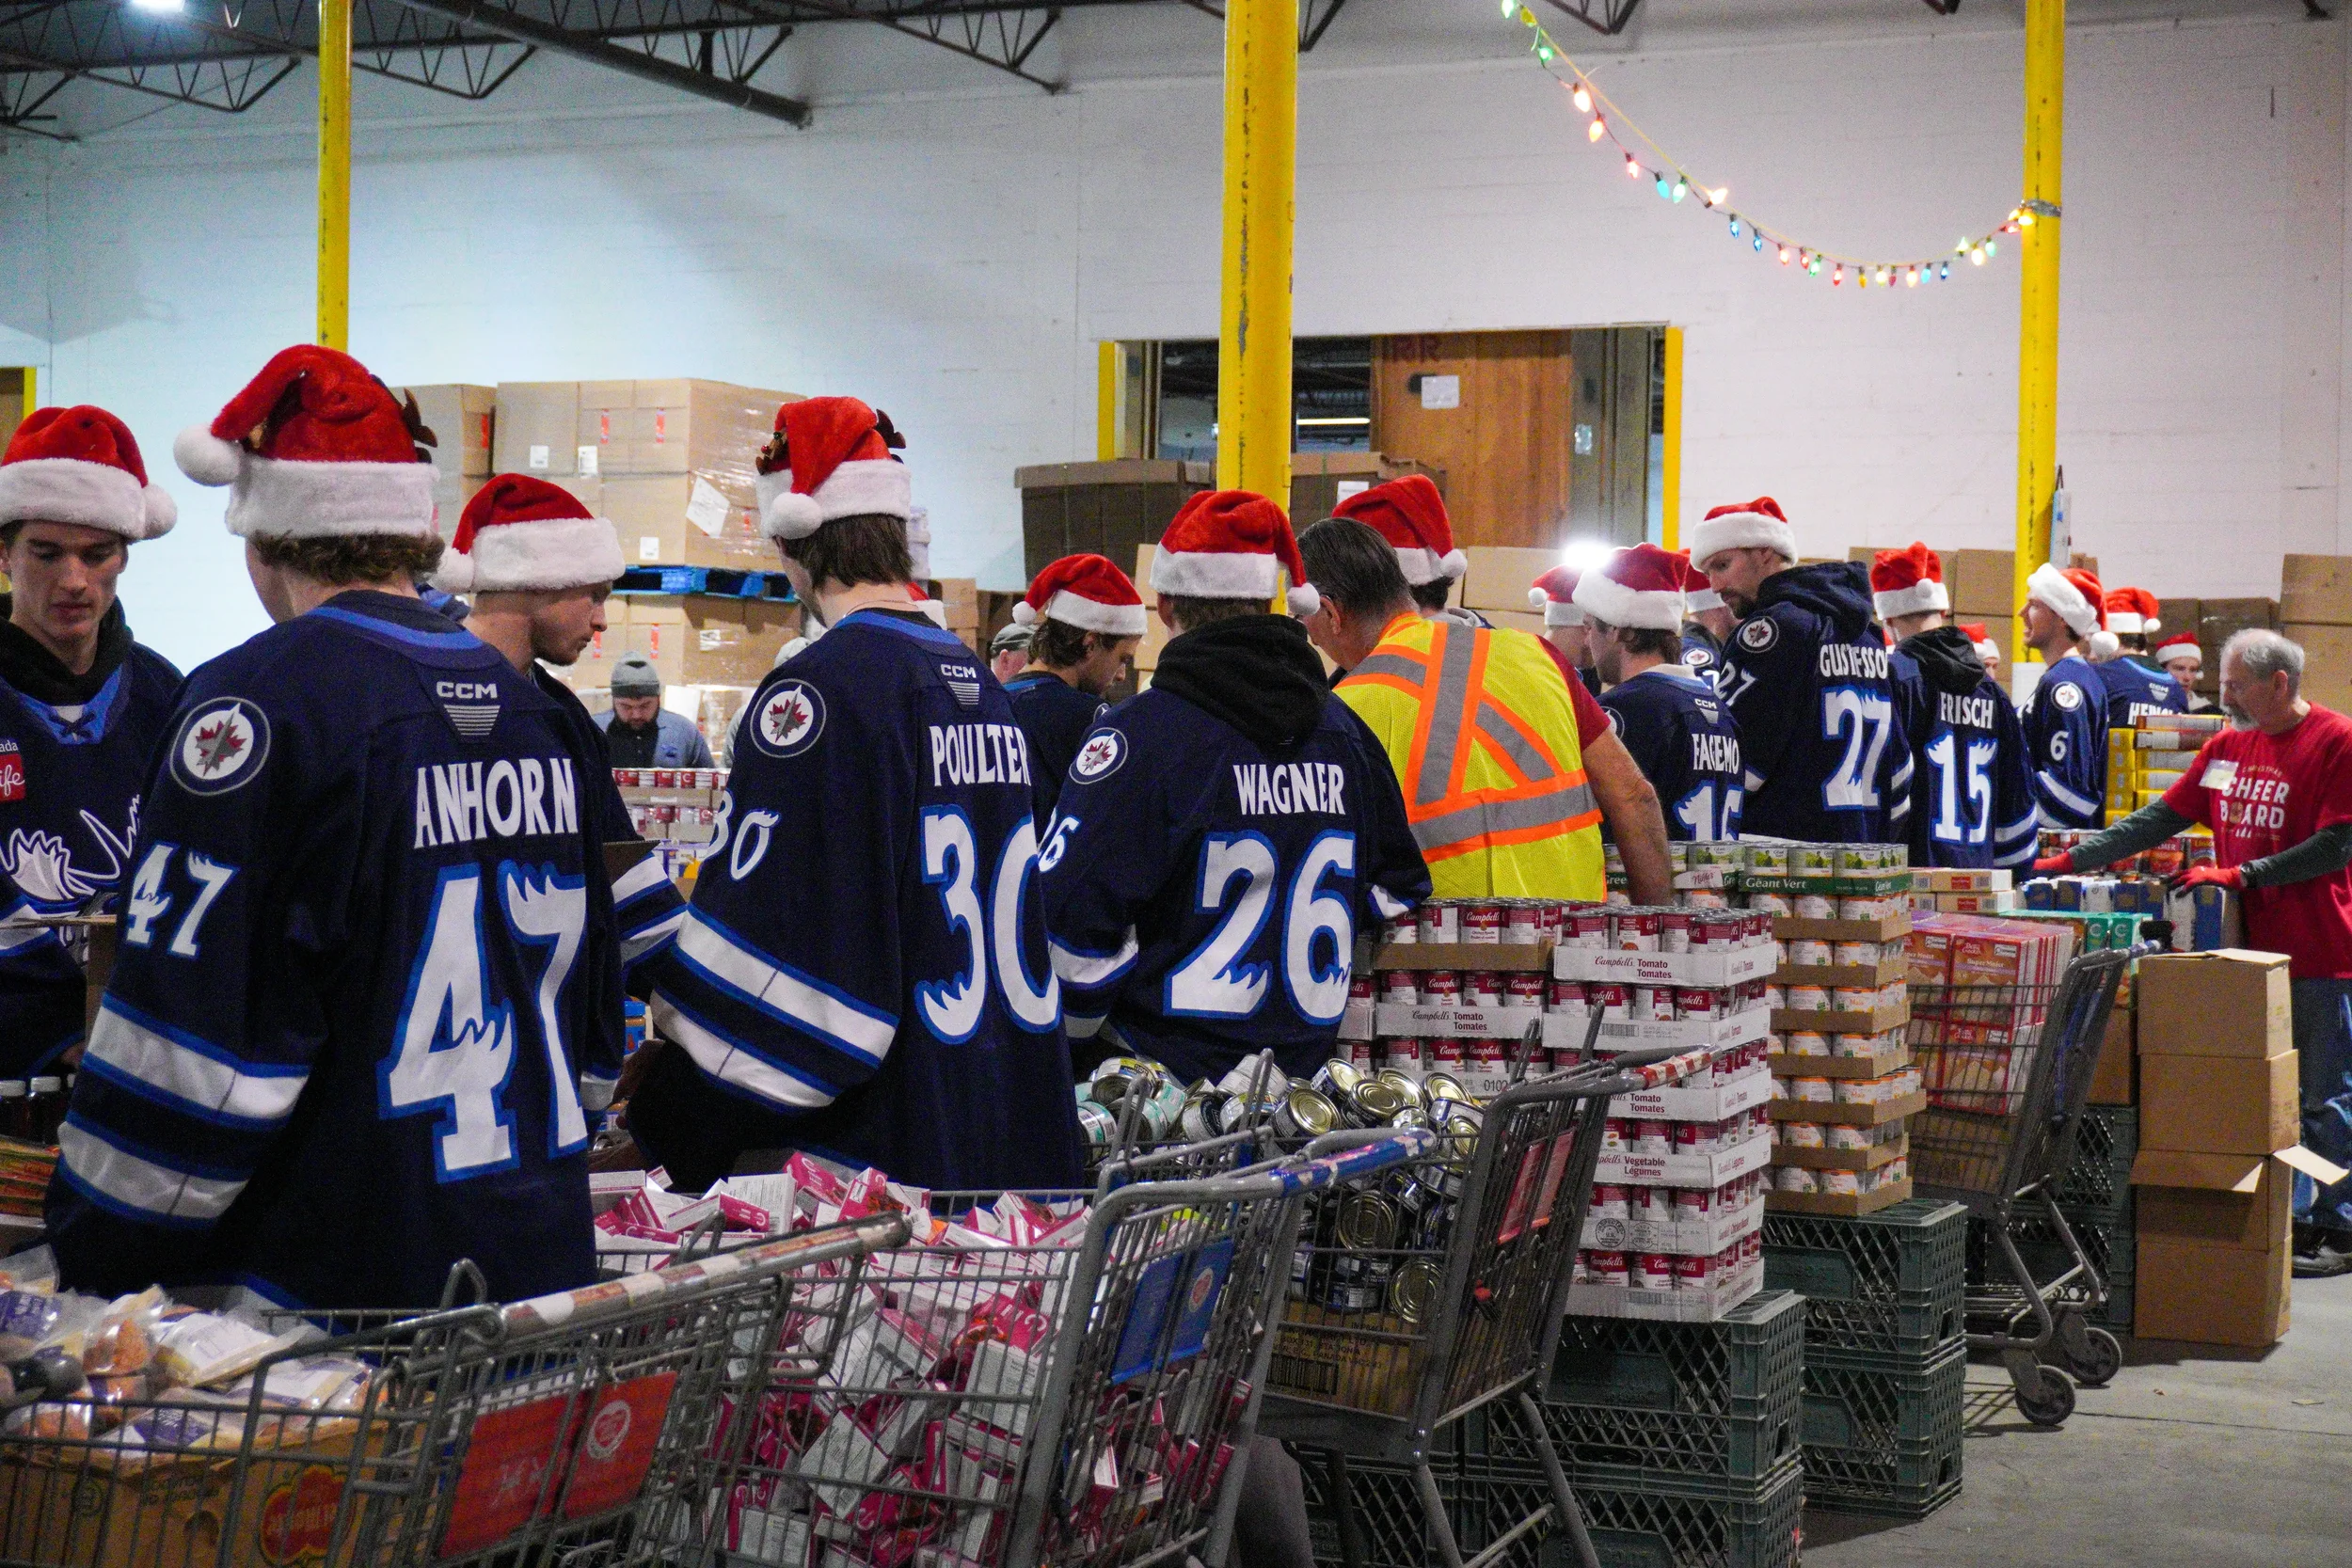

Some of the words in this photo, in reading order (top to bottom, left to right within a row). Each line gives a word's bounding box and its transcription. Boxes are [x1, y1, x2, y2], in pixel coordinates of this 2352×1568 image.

[941, 663, 977, 679] CCM
[435, 680, 499, 700] CCM
[1693, 698, 1717, 710] CCM
[1940, 691, 1994, 730] FRISCH
[929, 723, 1032, 787] POULTER
[1823, 688, 1892, 807] 27
[2050, 731, 2070, 761] 6
[1232, 762, 1346, 816] WAGNER
[1925, 732, 1998, 845] 15
[2221, 776, 2291, 804] CHEER
[413, 757, 580, 849] ANHORN
[1745, 877, 1781, 889] Géant
[1784, 878, 1807, 889] Vert
[126, 842, 239, 958] 47
[1168, 833, 1356, 1022] 26
[1594, 956, 1634, 970] Campbell's
[1637, 958, 1668, 969] Tomato
[1637, 969, 1672, 979] Tomates
[384, 867, 590, 1175] 47
[1412, 1011, 1450, 1022] Campbell's
[1454, 1012, 1484, 1021] Tomato
[1454, 1022, 1487, 1032] Tomates
[1630, 1092, 1661, 1102] Tomato
[1630, 1102, 1665, 1114] Tomates
[1624, 1155, 1665, 1168] Vegetable
[1624, 1165, 1661, 1178] Légumes
